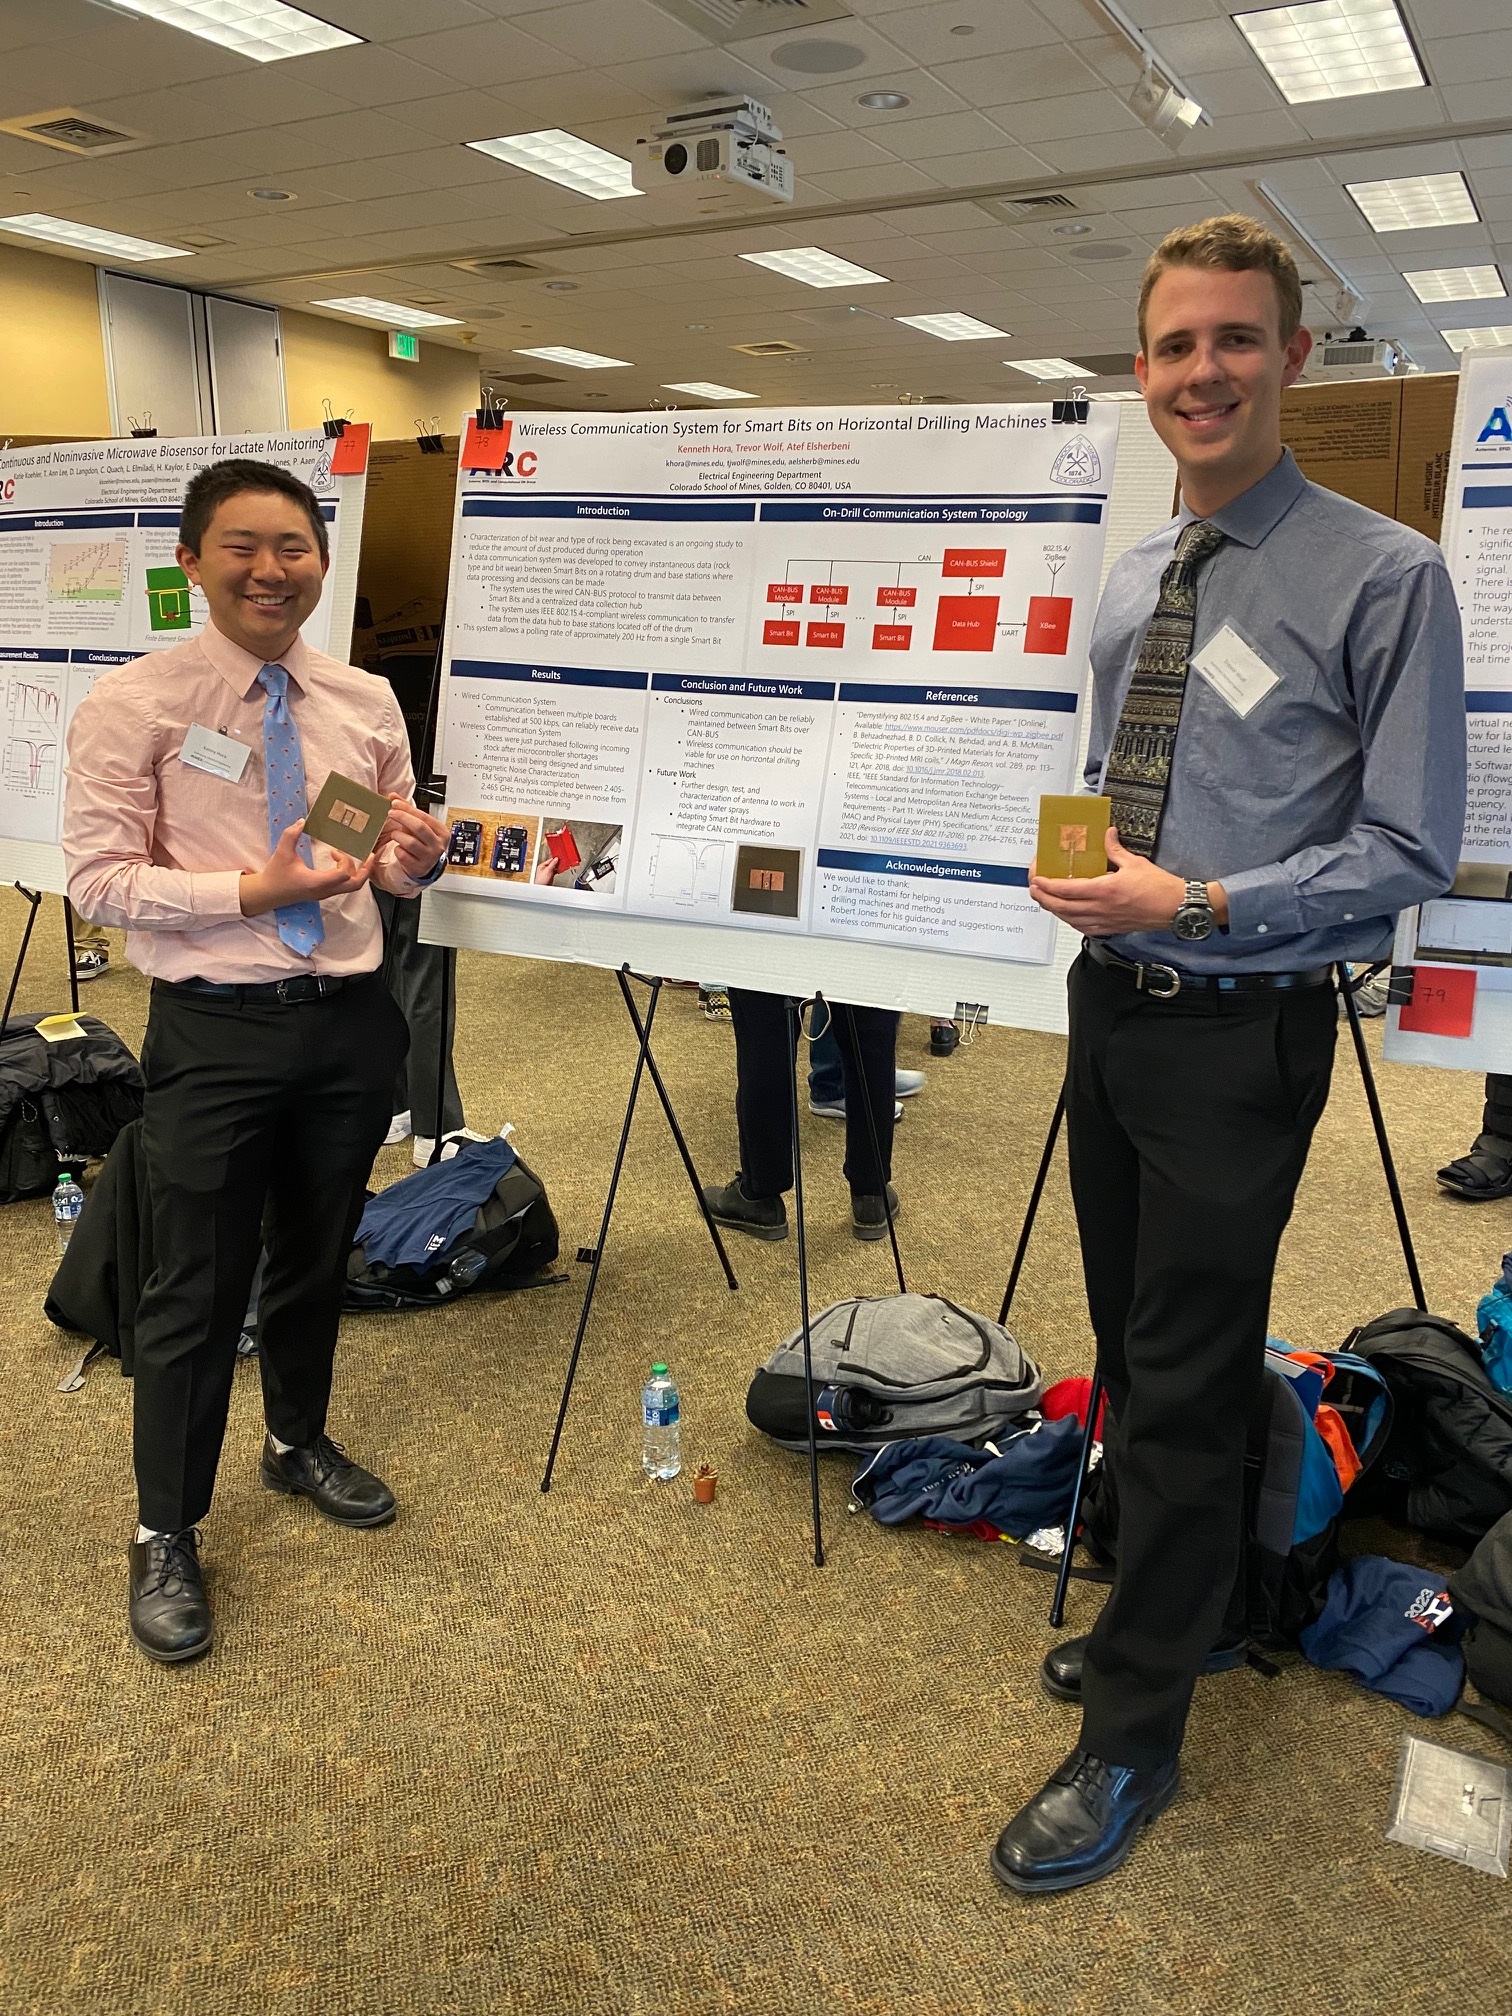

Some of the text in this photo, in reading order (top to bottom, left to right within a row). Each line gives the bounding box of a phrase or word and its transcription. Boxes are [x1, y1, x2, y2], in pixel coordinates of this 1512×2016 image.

[519, 416, 1047, 437] Wireless Communication System for Smart Bits on Horizontal Drilling Machines
[475, 436, 490, 448] 78
[677, 441, 850, 454] Kenneth Hora, Trevor Wolf, Atef Elsherbeni
[36, 453, 51, 466] and
[53, 448, 104, 463] Noninvasive
[106, 447, 157, 459] Microwave
[160, 445, 208, 457] Biosensor
[211, 443, 227, 455] for
[229, 443, 264, 454] Lactate
[267, 439, 325, 454] Monitoring
[293, 458, 299, 466] P.
[698, 471, 822, 482] Electrical Engineering Department
[669, 482, 851, 491] Colorado School of Mines, Golden, CO 80401, USA
[577, 504, 630, 516] Introduction
[823, 508, 1028, 522] On-Drill Communication System Topology
[34, 519, 64, 528] Introduction
[1482, 527, 1500, 535] The
[469, 533, 520, 542] Characterization
[521, 534, 528, 542] of
[529, 535, 538, 543] bit
[556, 535, 570, 543] and
[570, 536, 585, 546] type
[587, 536, 595, 544] of
[596, 536, 611, 544] rock
[612, 537, 632, 547] being
[633, 538, 667, 546] excavated
[668, 538, 674, 546] is
[686, 539, 714, 549] ongoing
[715, 539, 734, 549] study
[735, 540, 743, 548] to
[1476, 564, 1508, 576] signal.
[1476, 578, 1504, 586] There
[1473, 604, 1490, 612] The
[1469, 630, 1498, 638] alone.
[1468, 642, 1488, 651] This
[88, 654, 130, 664] Conclusion and
[1466, 655, 1510, 664] real time
[531, 669, 561, 680] Results
[681, 679, 803, 694] Conclusion and Future Work
[664, 696, 702, 706] Conclusions
[926, 690, 979, 702] References
[1469, 719, 1500, 728] virtual
[1486, 732, 1500, 741] for
[656, 769, 697, 779] Future Work
[1478, 813, 1507, 824] signal
[1474, 825, 1490, 834] the
[885, 859, 982, 878] Acknowledgements
[823, 873, 910, 888] We would like to thank:
[832, 884, 843, 893] Dr.
[845, 885, 866, 895] Jamal
[868, 888, 898, 898] Rostami
[900, 890, 911, 899] for
[912, 892, 941, 904] helping
[954, 897, 998, 908] understand
[1000, 900, 1041, 912] horizontal
